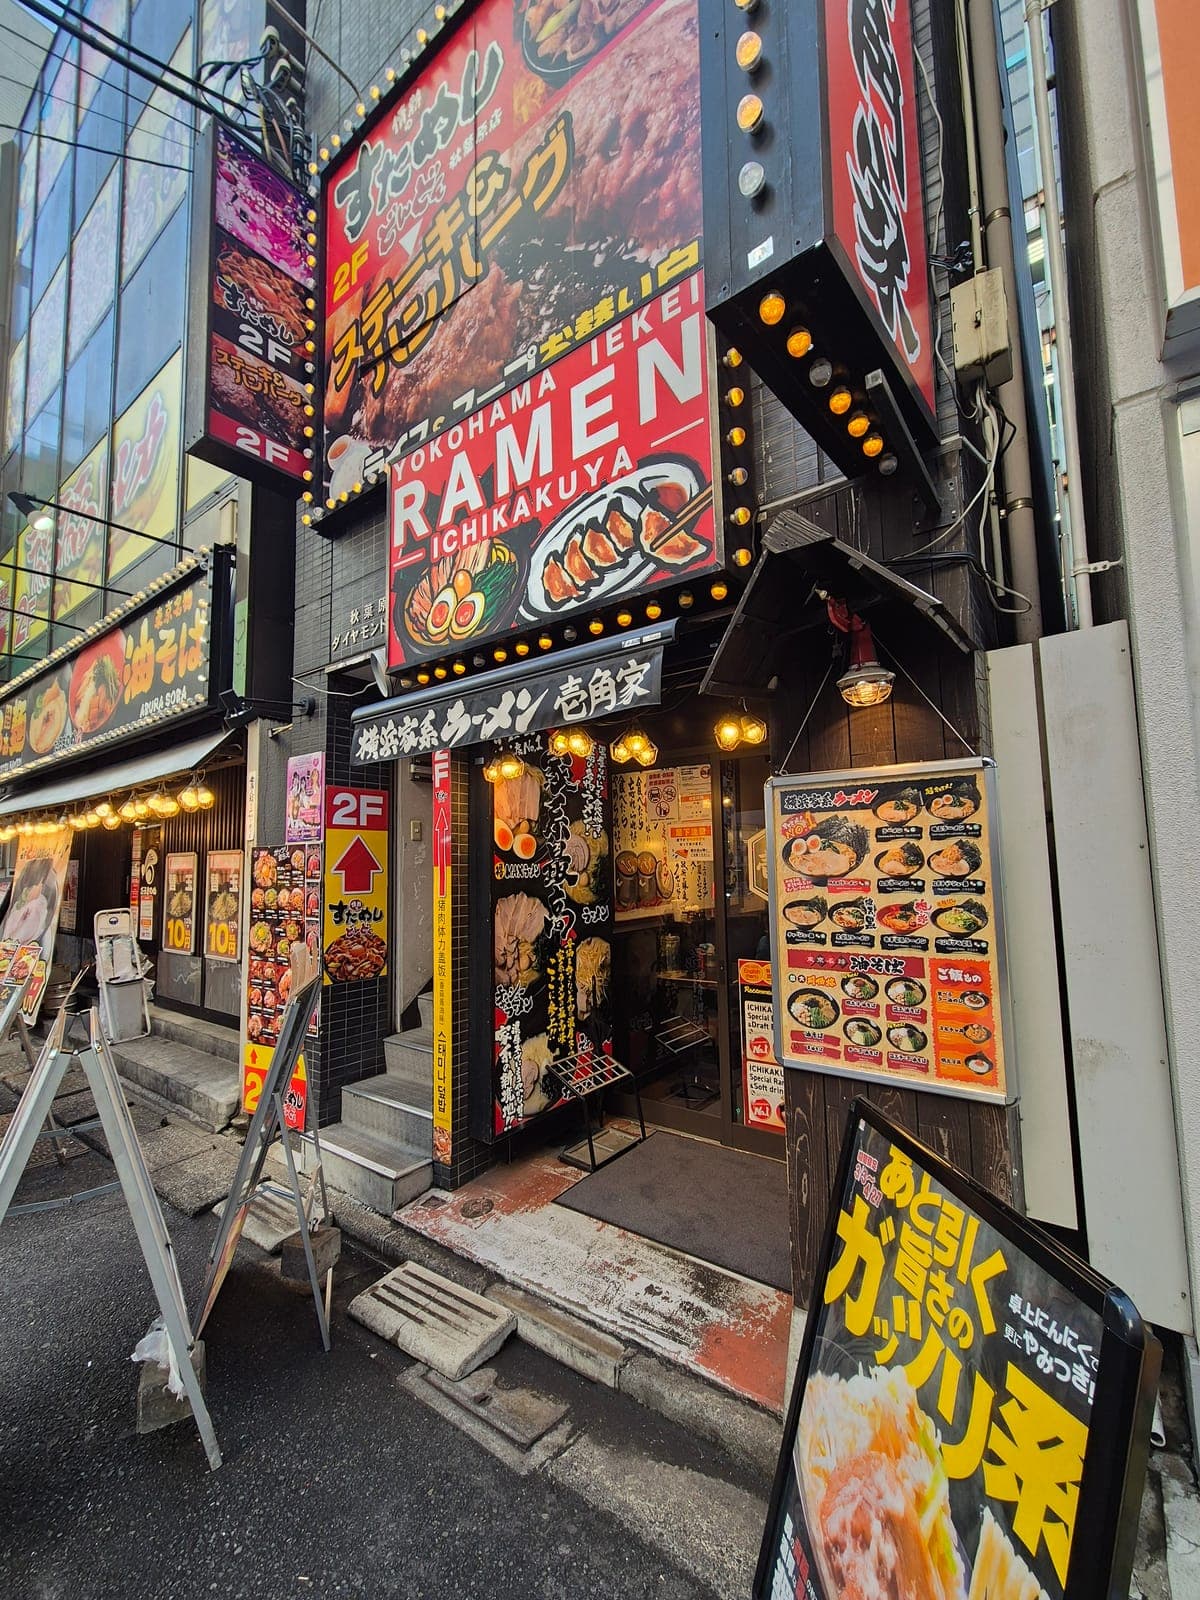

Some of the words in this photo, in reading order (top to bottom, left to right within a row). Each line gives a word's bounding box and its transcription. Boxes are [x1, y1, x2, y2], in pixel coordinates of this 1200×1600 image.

[333, 239, 371, 304] 2F
[370, 112, 574, 394] ハンバーグ
[238, 323, 292, 364] 2F
[393, 370, 556, 481] YOKOHAMA
[591, 275, 699, 366] IEKEI
[235, 426, 290, 462] 2F
[394, 312, 703, 546] RAMEN
[432, 446, 634, 560] ICHIKAKUYA
[123, 608, 207, 704] 油そば
[355, 709, 440, 762] 横浜家系
[440, 687, 549, 747] ラーメン
[553, 658, 651, 722] 壱角家
[332, 793, 383, 826] 2F
[833, 789, 879, 807] ラーメン
[167, 918, 185, 948] 10
[209, 922, 229, 954] 10
[328, 899, 384, 925] すためし
[850, 956, 905, 974] 油そば
[747, 1012, 770, 1022] Special
[749, 1073, 772, 1083] Special
[880, 1144, 1008, 1335] あと引く
[894, 1221, 974, 1349] 旨さの
[824, 1193, 1089, 1591] ガッツリ系
[1003, 1322, 1096, 1406] 更にやみつき!
